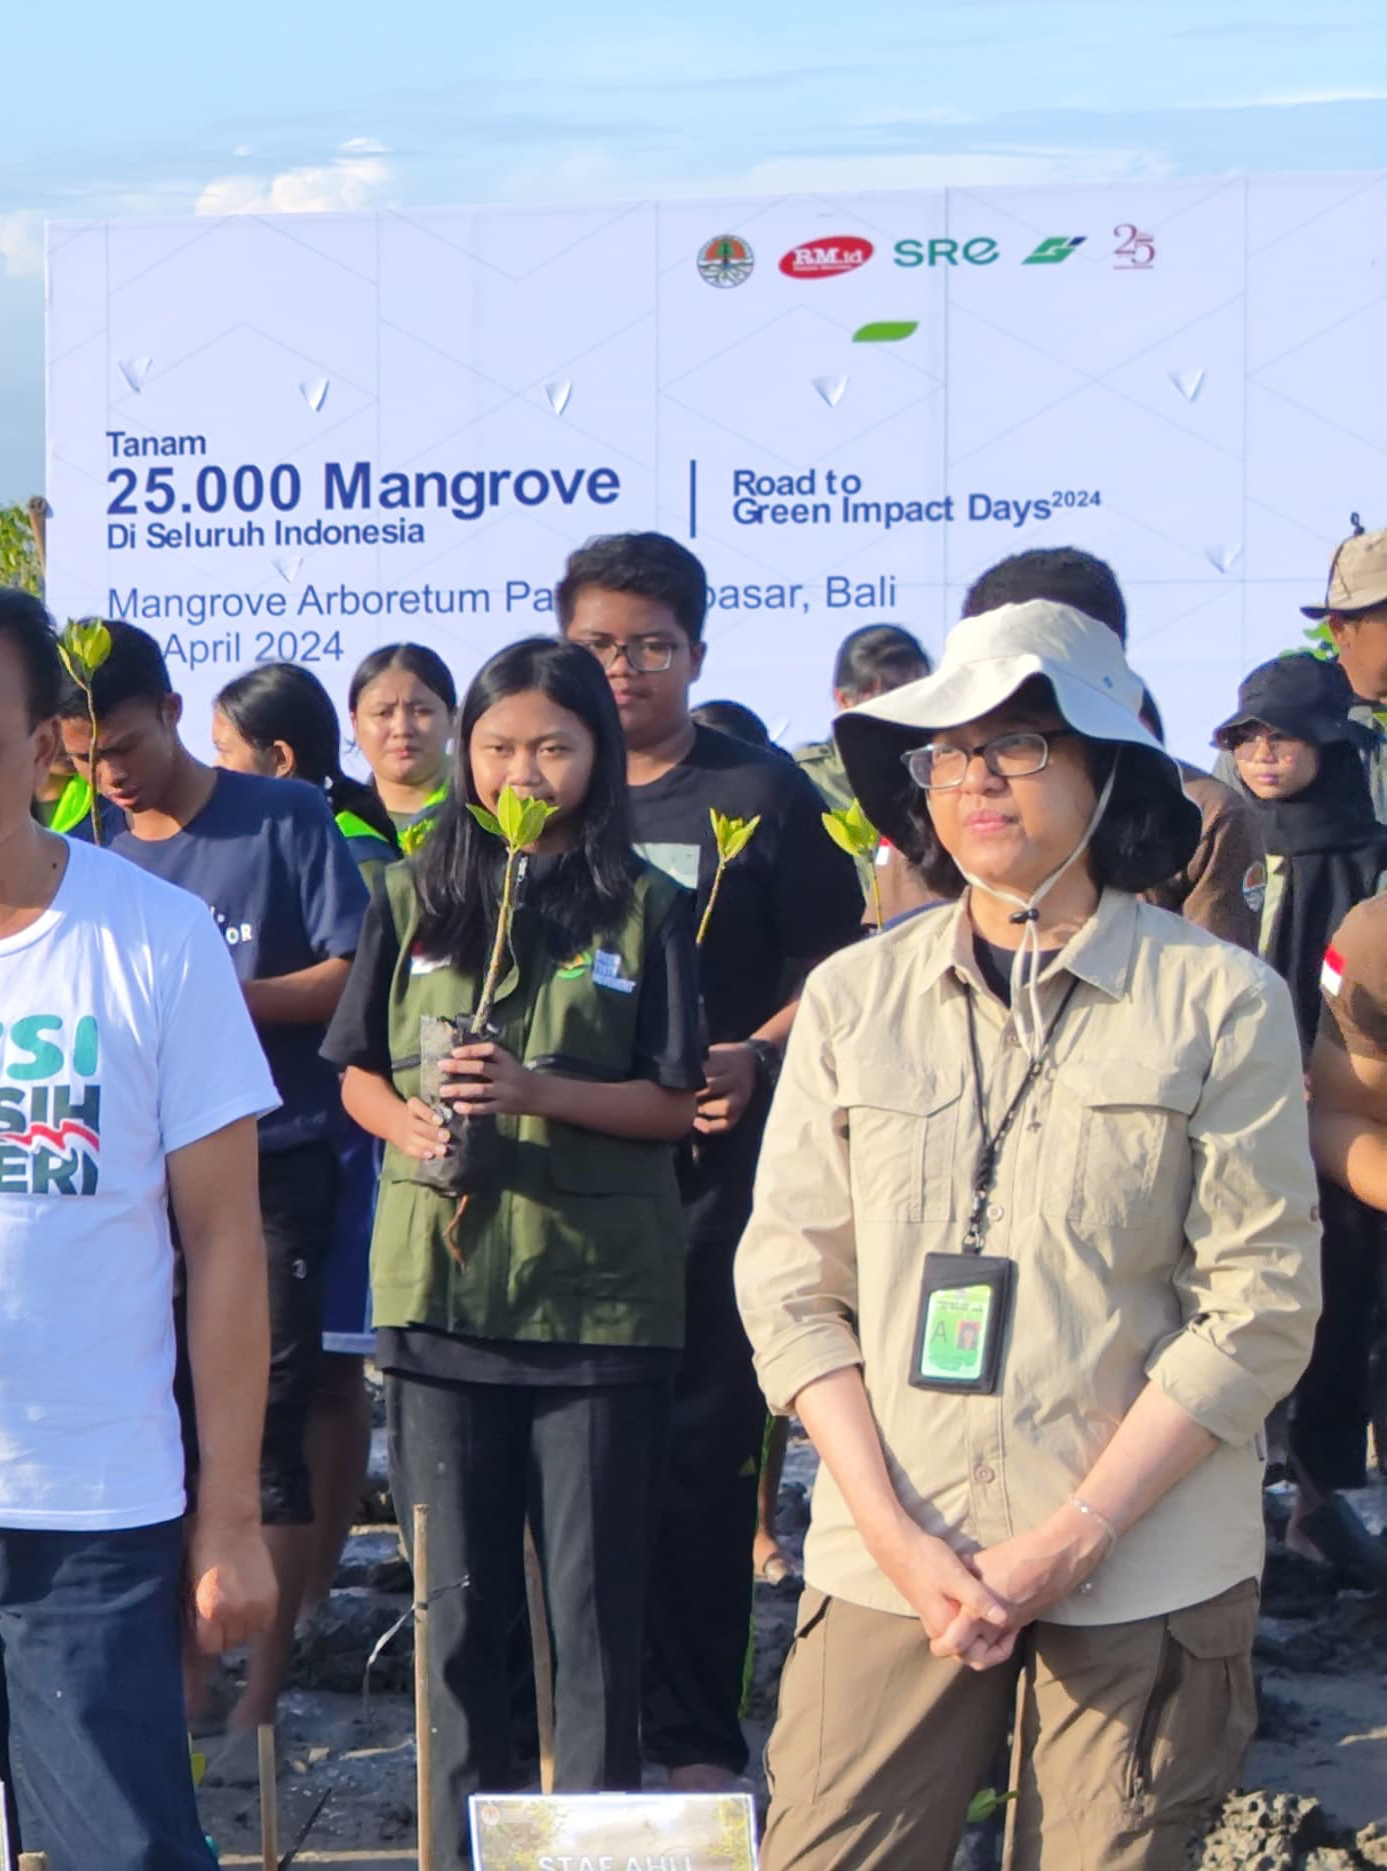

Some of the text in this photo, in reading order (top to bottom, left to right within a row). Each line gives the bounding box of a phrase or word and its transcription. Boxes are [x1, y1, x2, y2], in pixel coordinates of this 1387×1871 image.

[795, 246, 863, 265] RM.id
[1113, 223, 1155, 264] 25
[106, 431, 206, 457] Tanam
[107, 461, 621, 520] 25.000 Mangrove
[733, 468, 862, 497] Road to
[732, 497, 831, 525] Green
[842, 495, 954, 529] Impact
[107, 517, 425, 549] Di Seluruh Indonesia
[108, 580, 556, 626] Mangrove Arboretum Pa
[705, 575, 897, 614] asar, Bali
[163, 630, 344, 670] April 2024
